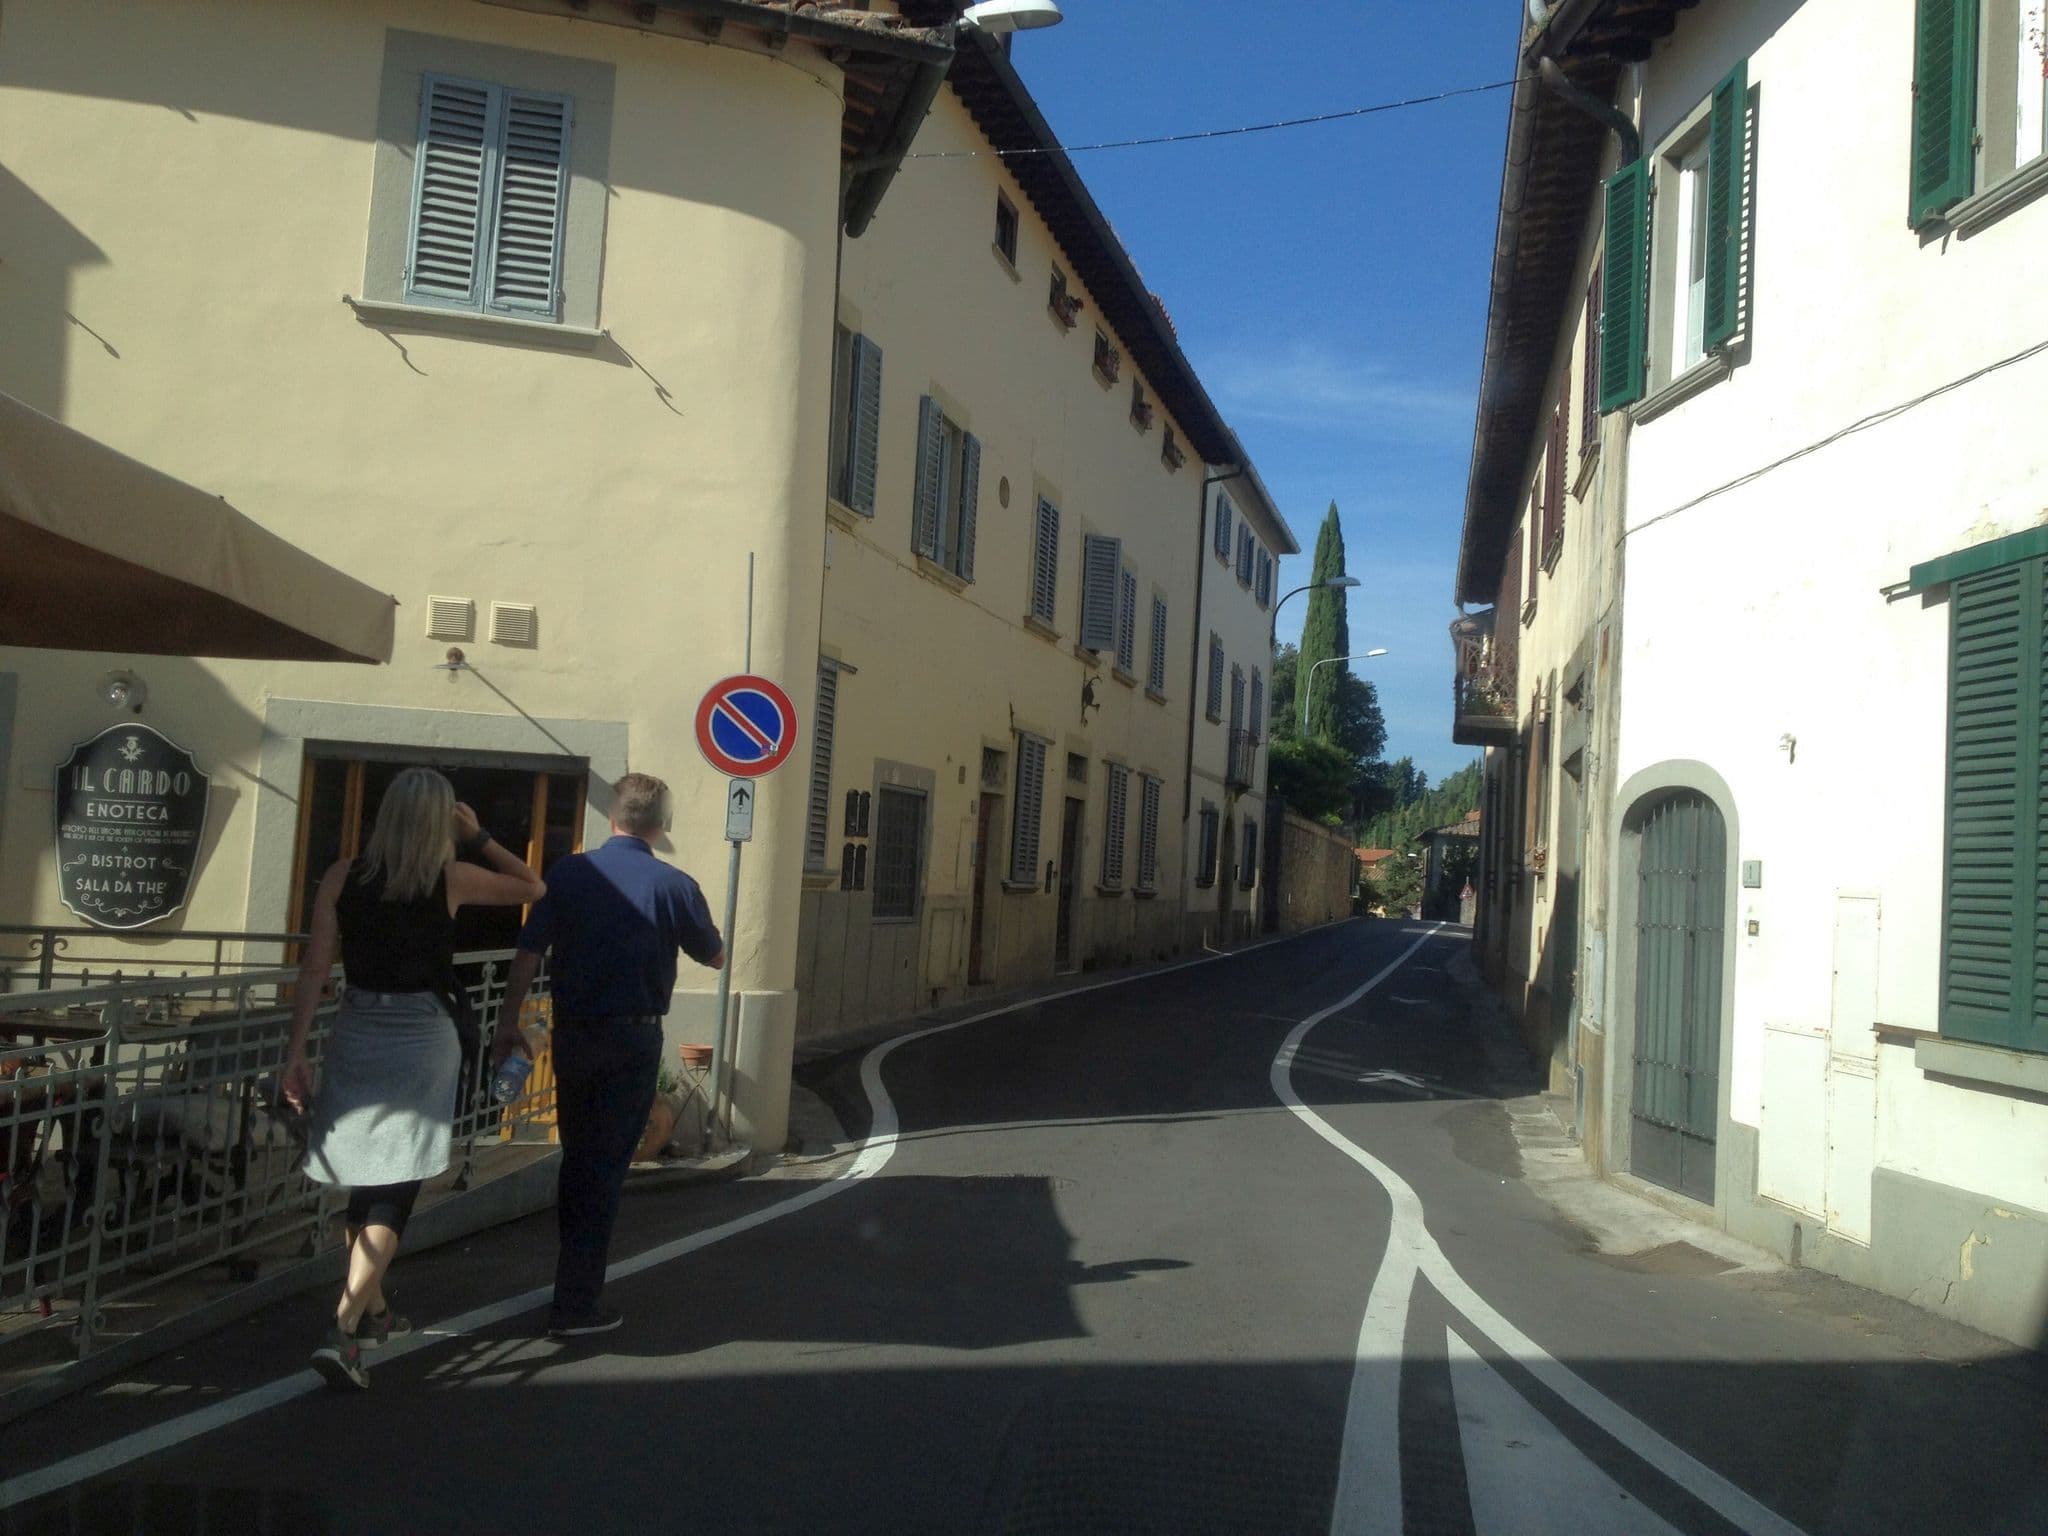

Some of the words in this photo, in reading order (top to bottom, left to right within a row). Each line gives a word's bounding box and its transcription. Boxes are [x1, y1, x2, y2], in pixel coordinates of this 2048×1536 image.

[72, 766, 95, 791] IL
[103, 768, 191, 796] CARDO
[86, 802, 168, 820] ENOTECA
[91, 854, 156, 869] BISTROT
[76, 878, 110, 892] SALA
[115, 880, 132, 893] DA
